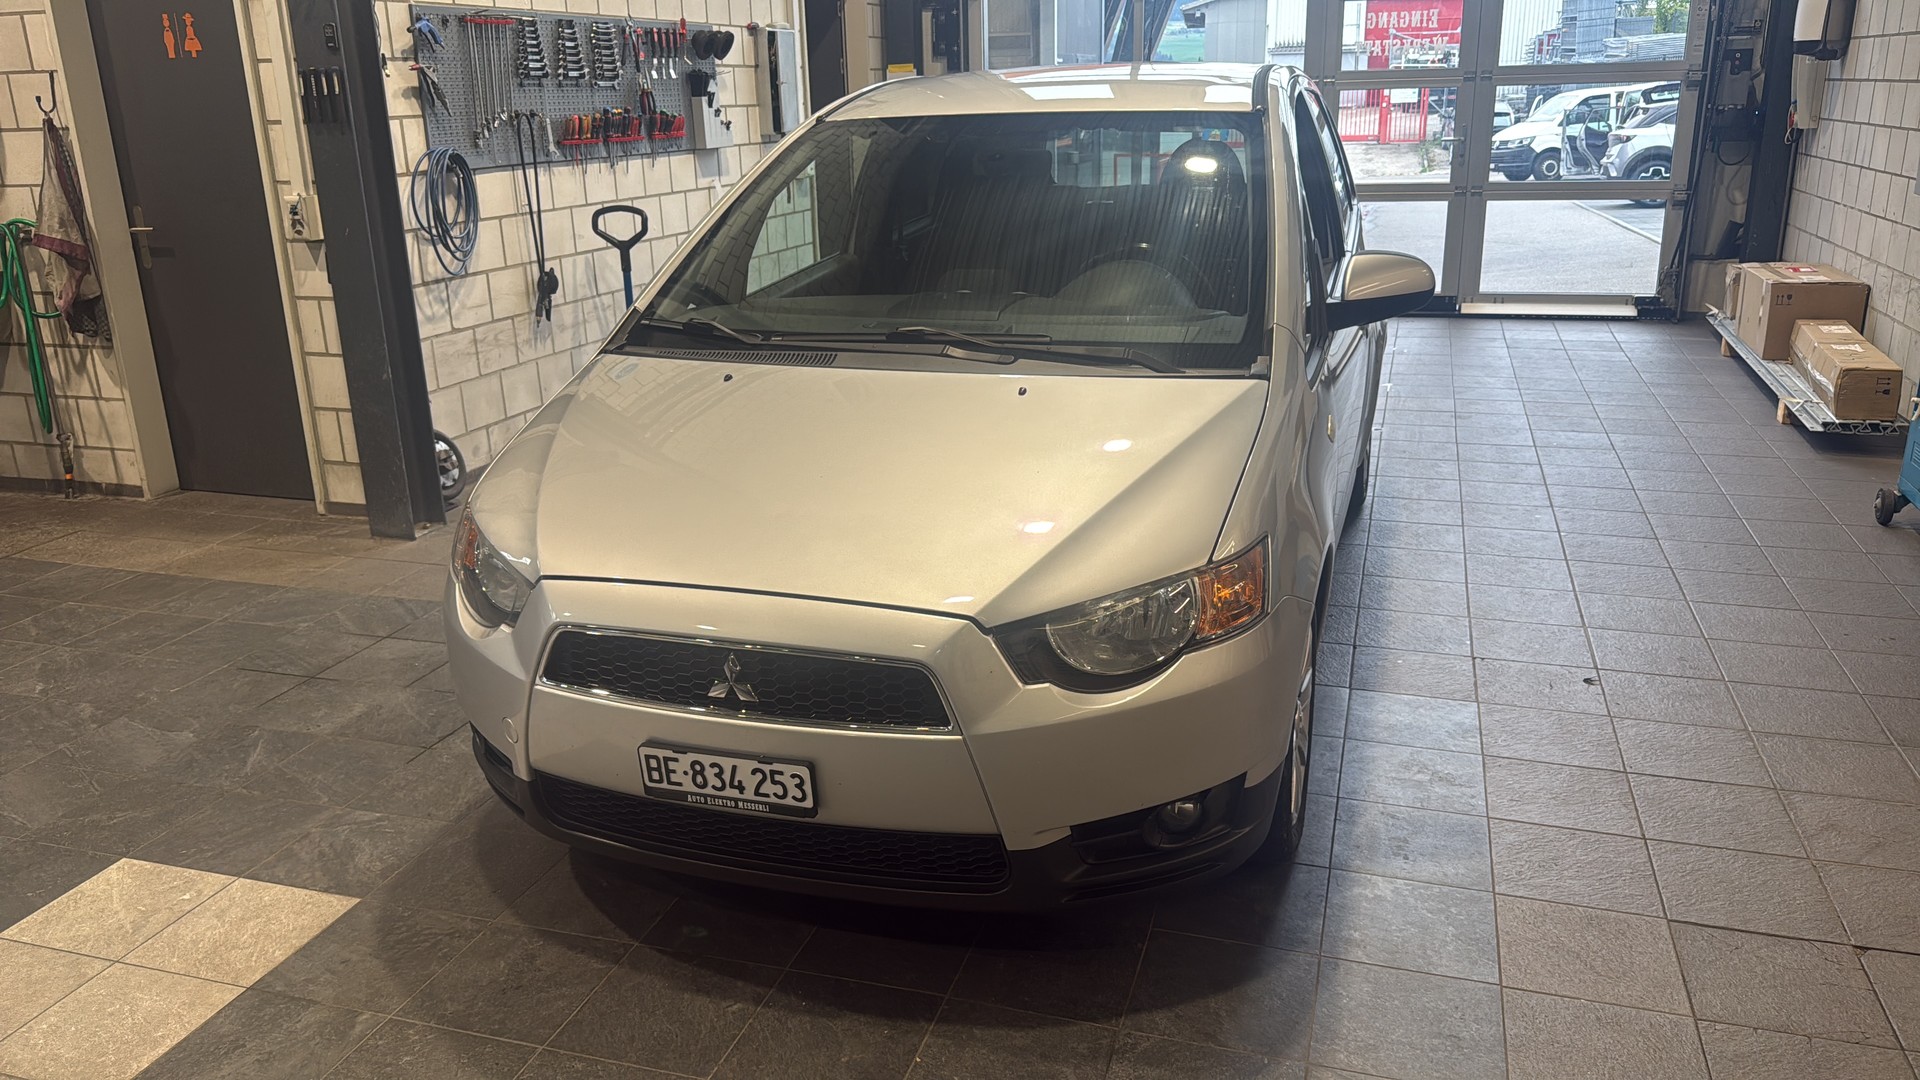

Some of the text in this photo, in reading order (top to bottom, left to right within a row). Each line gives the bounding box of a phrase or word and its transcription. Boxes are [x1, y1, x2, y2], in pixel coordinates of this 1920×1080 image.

[751, 767, 807, 803] 253
[687, 794, 770, 812] AUTO ELEKTRO MESSERLI
